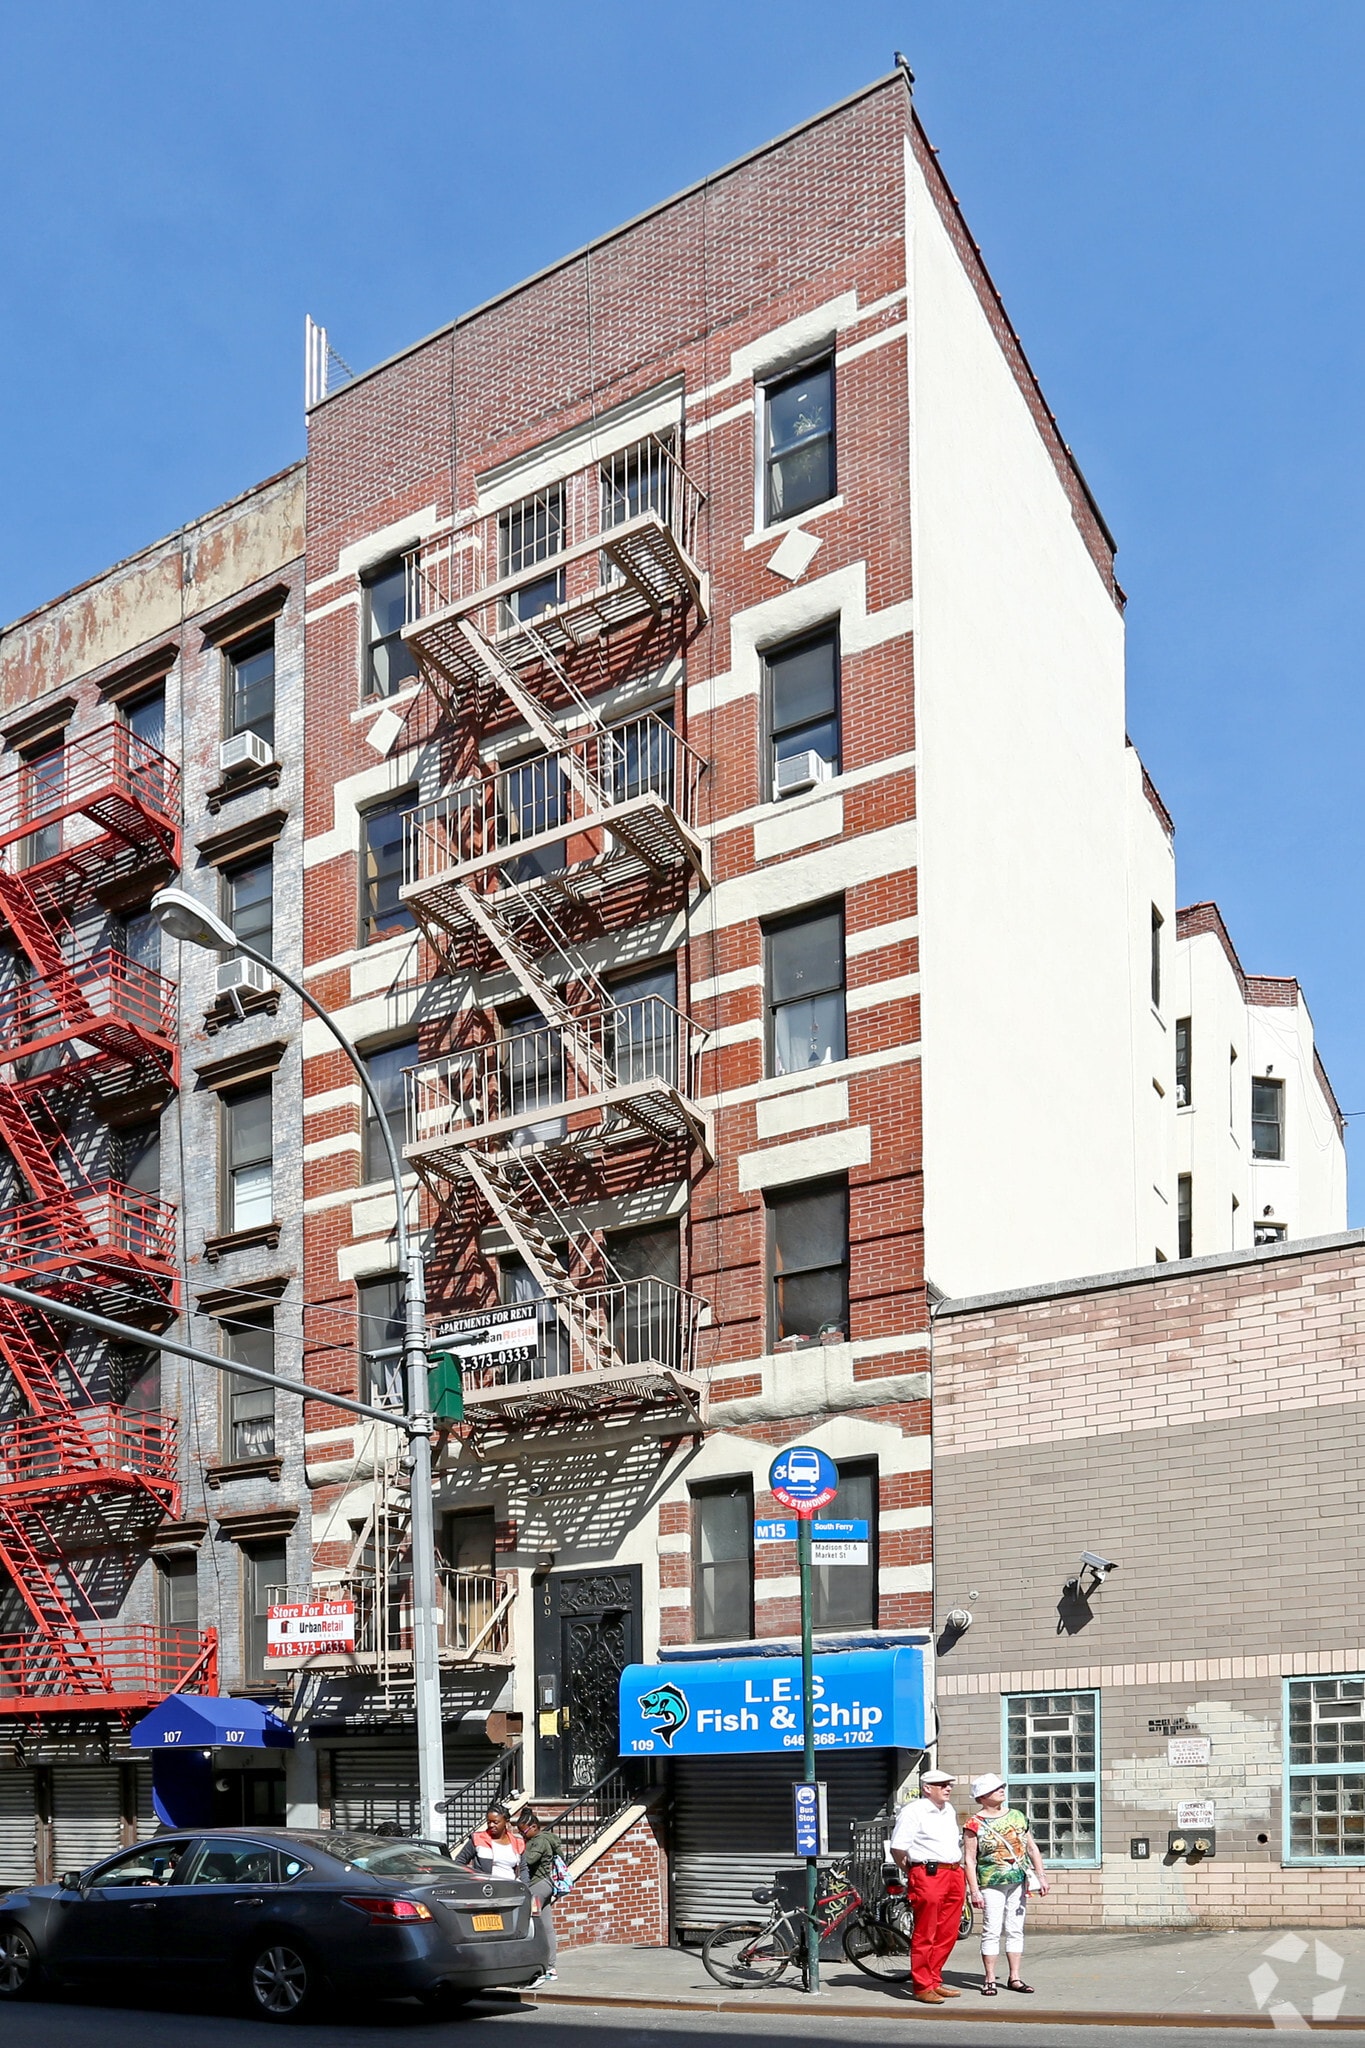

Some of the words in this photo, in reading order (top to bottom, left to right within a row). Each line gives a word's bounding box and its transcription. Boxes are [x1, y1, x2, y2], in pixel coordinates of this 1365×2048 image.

[439, 1314, 491, 1335] APARTMENTS
[492, 1311, 509, 1322] FOR
[510, 1306, 534, 1319] RENT
[776, 1491, 789, 1503] NO
[790, 1492, 831, 1508] STANDING
[757, 1523, 786, 1538] M15
[814, 1523, 834, 1531] South
[836, 1523, 854, 1532] Ferry
[543, 1583, 551, 1618] 109
[272, 1606, 299, 1619] Store
[302, 1604, 320, 1617] For
[323, 1602, 348, 1615] Rent
[299, 1620, 344, 1634] UrbanRetail
[274, 1640, 346, 1656] 718-373-0333
[744, 1675, 825, 1703] L.E.S
[696, 1706, 759, 1733] Fish
[769, 1705, 798, 1730] &
[811, 1701, 883, 1730] Chip
[163, 1731, 182, 1743] 107
[225, 1731, 245, 1743] 107
[782, 1731, 874, 1747] 646368-1702
[630, 1739, 654, 1751] 109
[799, 1806, 814, 1814] Bus
[798, 1814, 816, 1823] Stop
